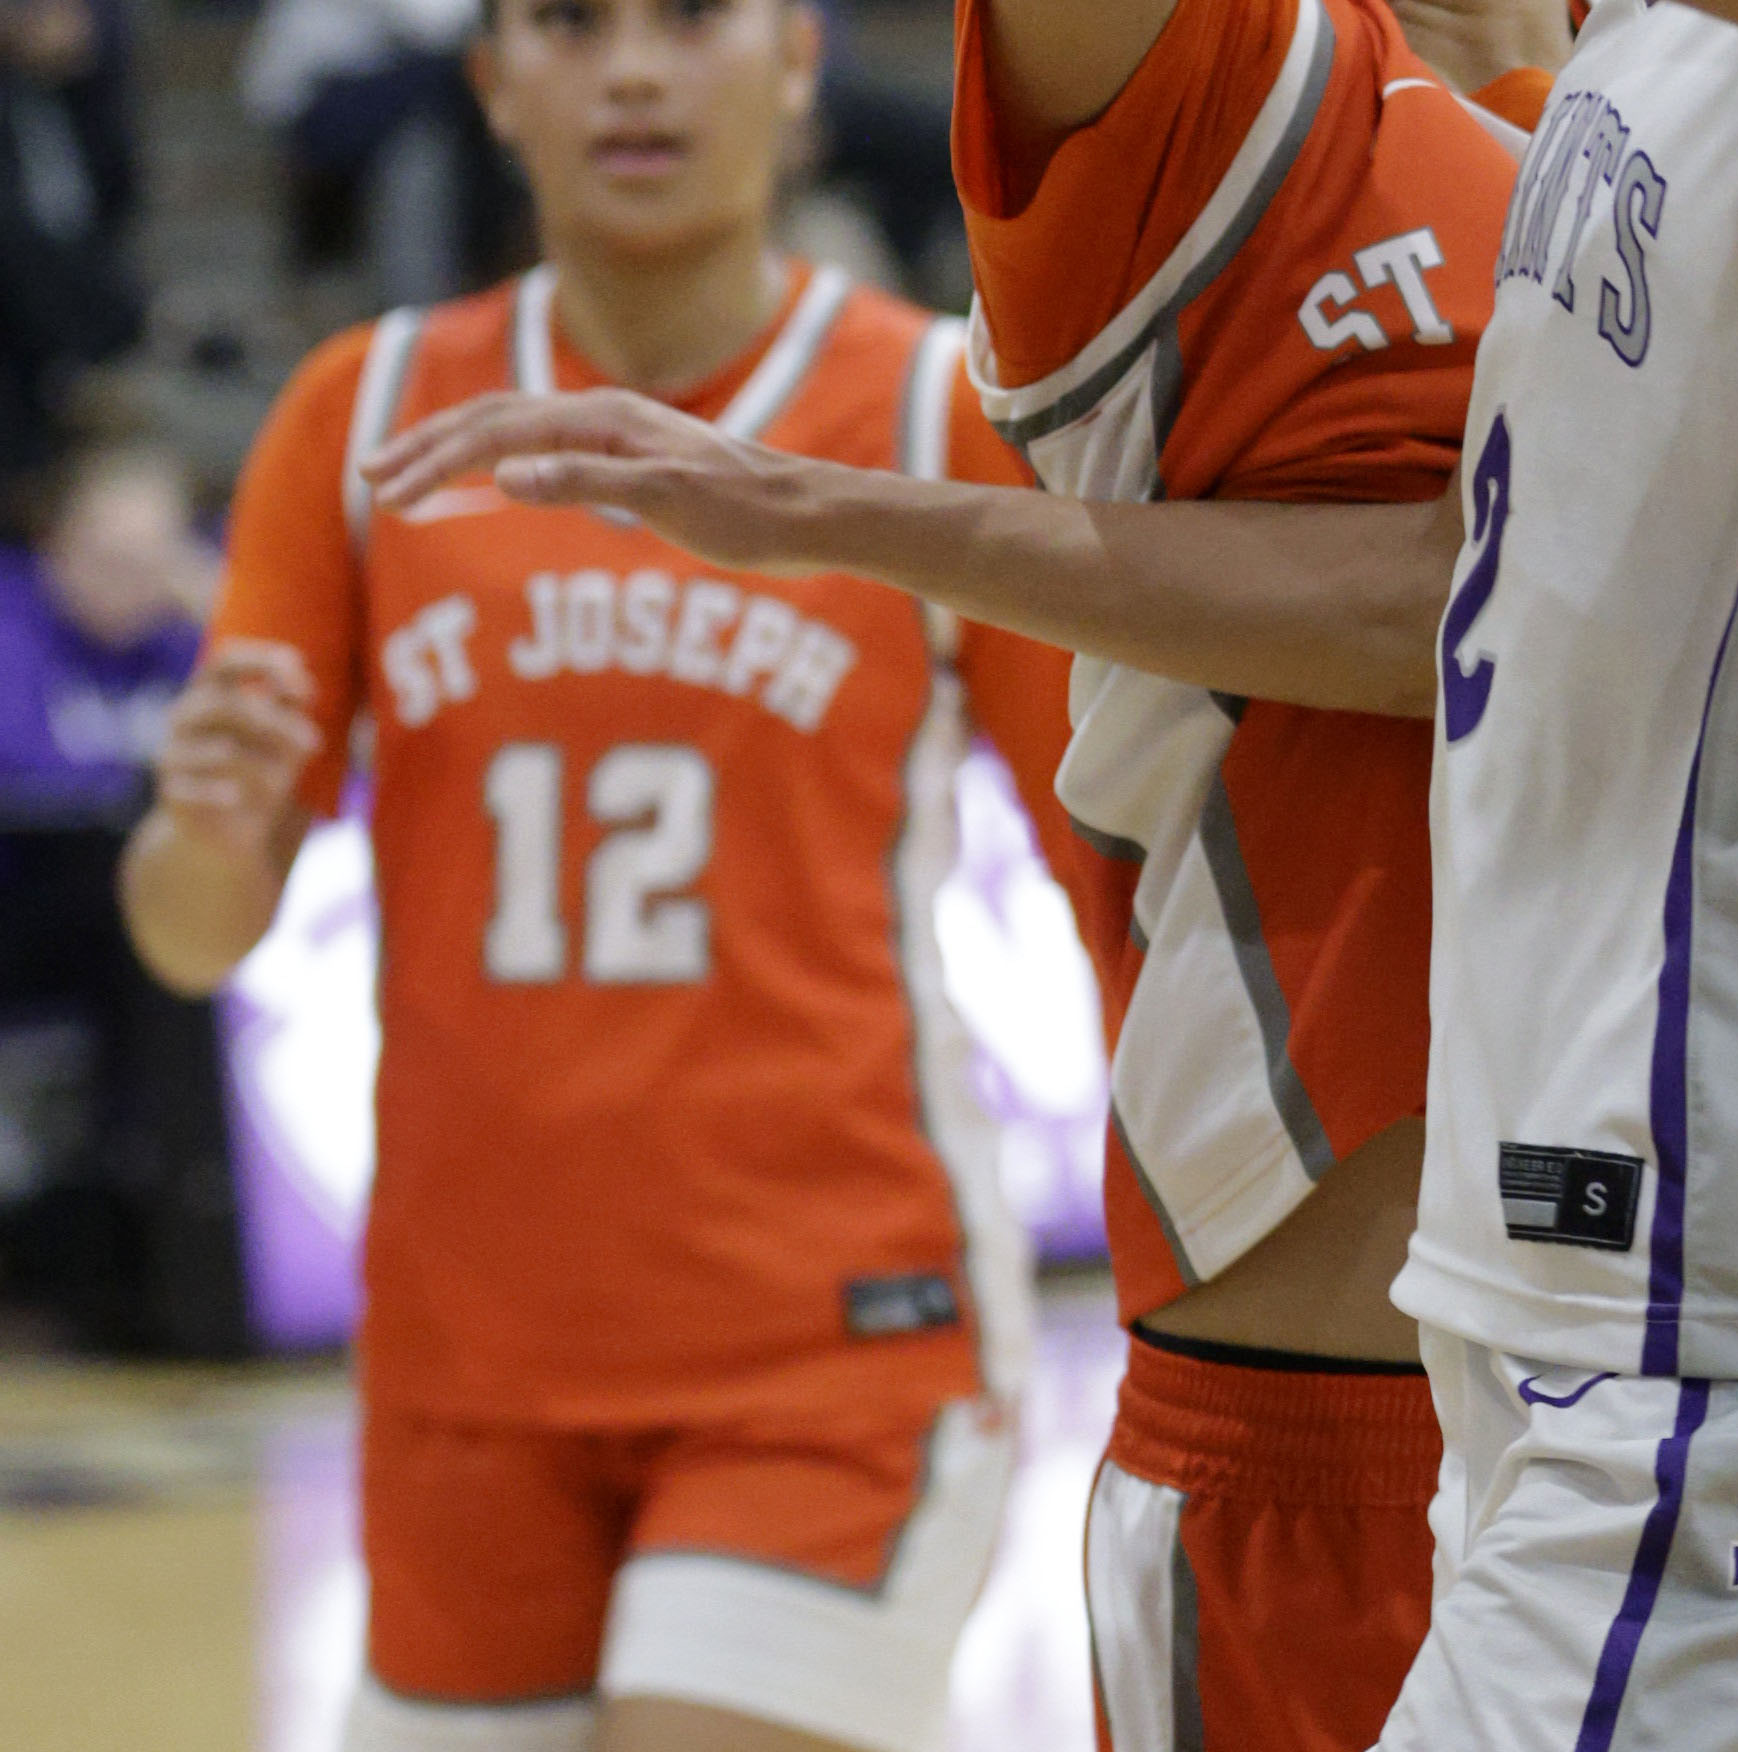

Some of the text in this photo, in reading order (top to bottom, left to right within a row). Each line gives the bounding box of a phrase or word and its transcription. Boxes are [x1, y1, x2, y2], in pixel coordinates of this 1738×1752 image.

[1299, 227, 1455, 349] ST
[382, 568, 858, 732] ST JOSEPH
[483, 741, 713, 985] 12
[1582, 1181, 1608, 1216] S
